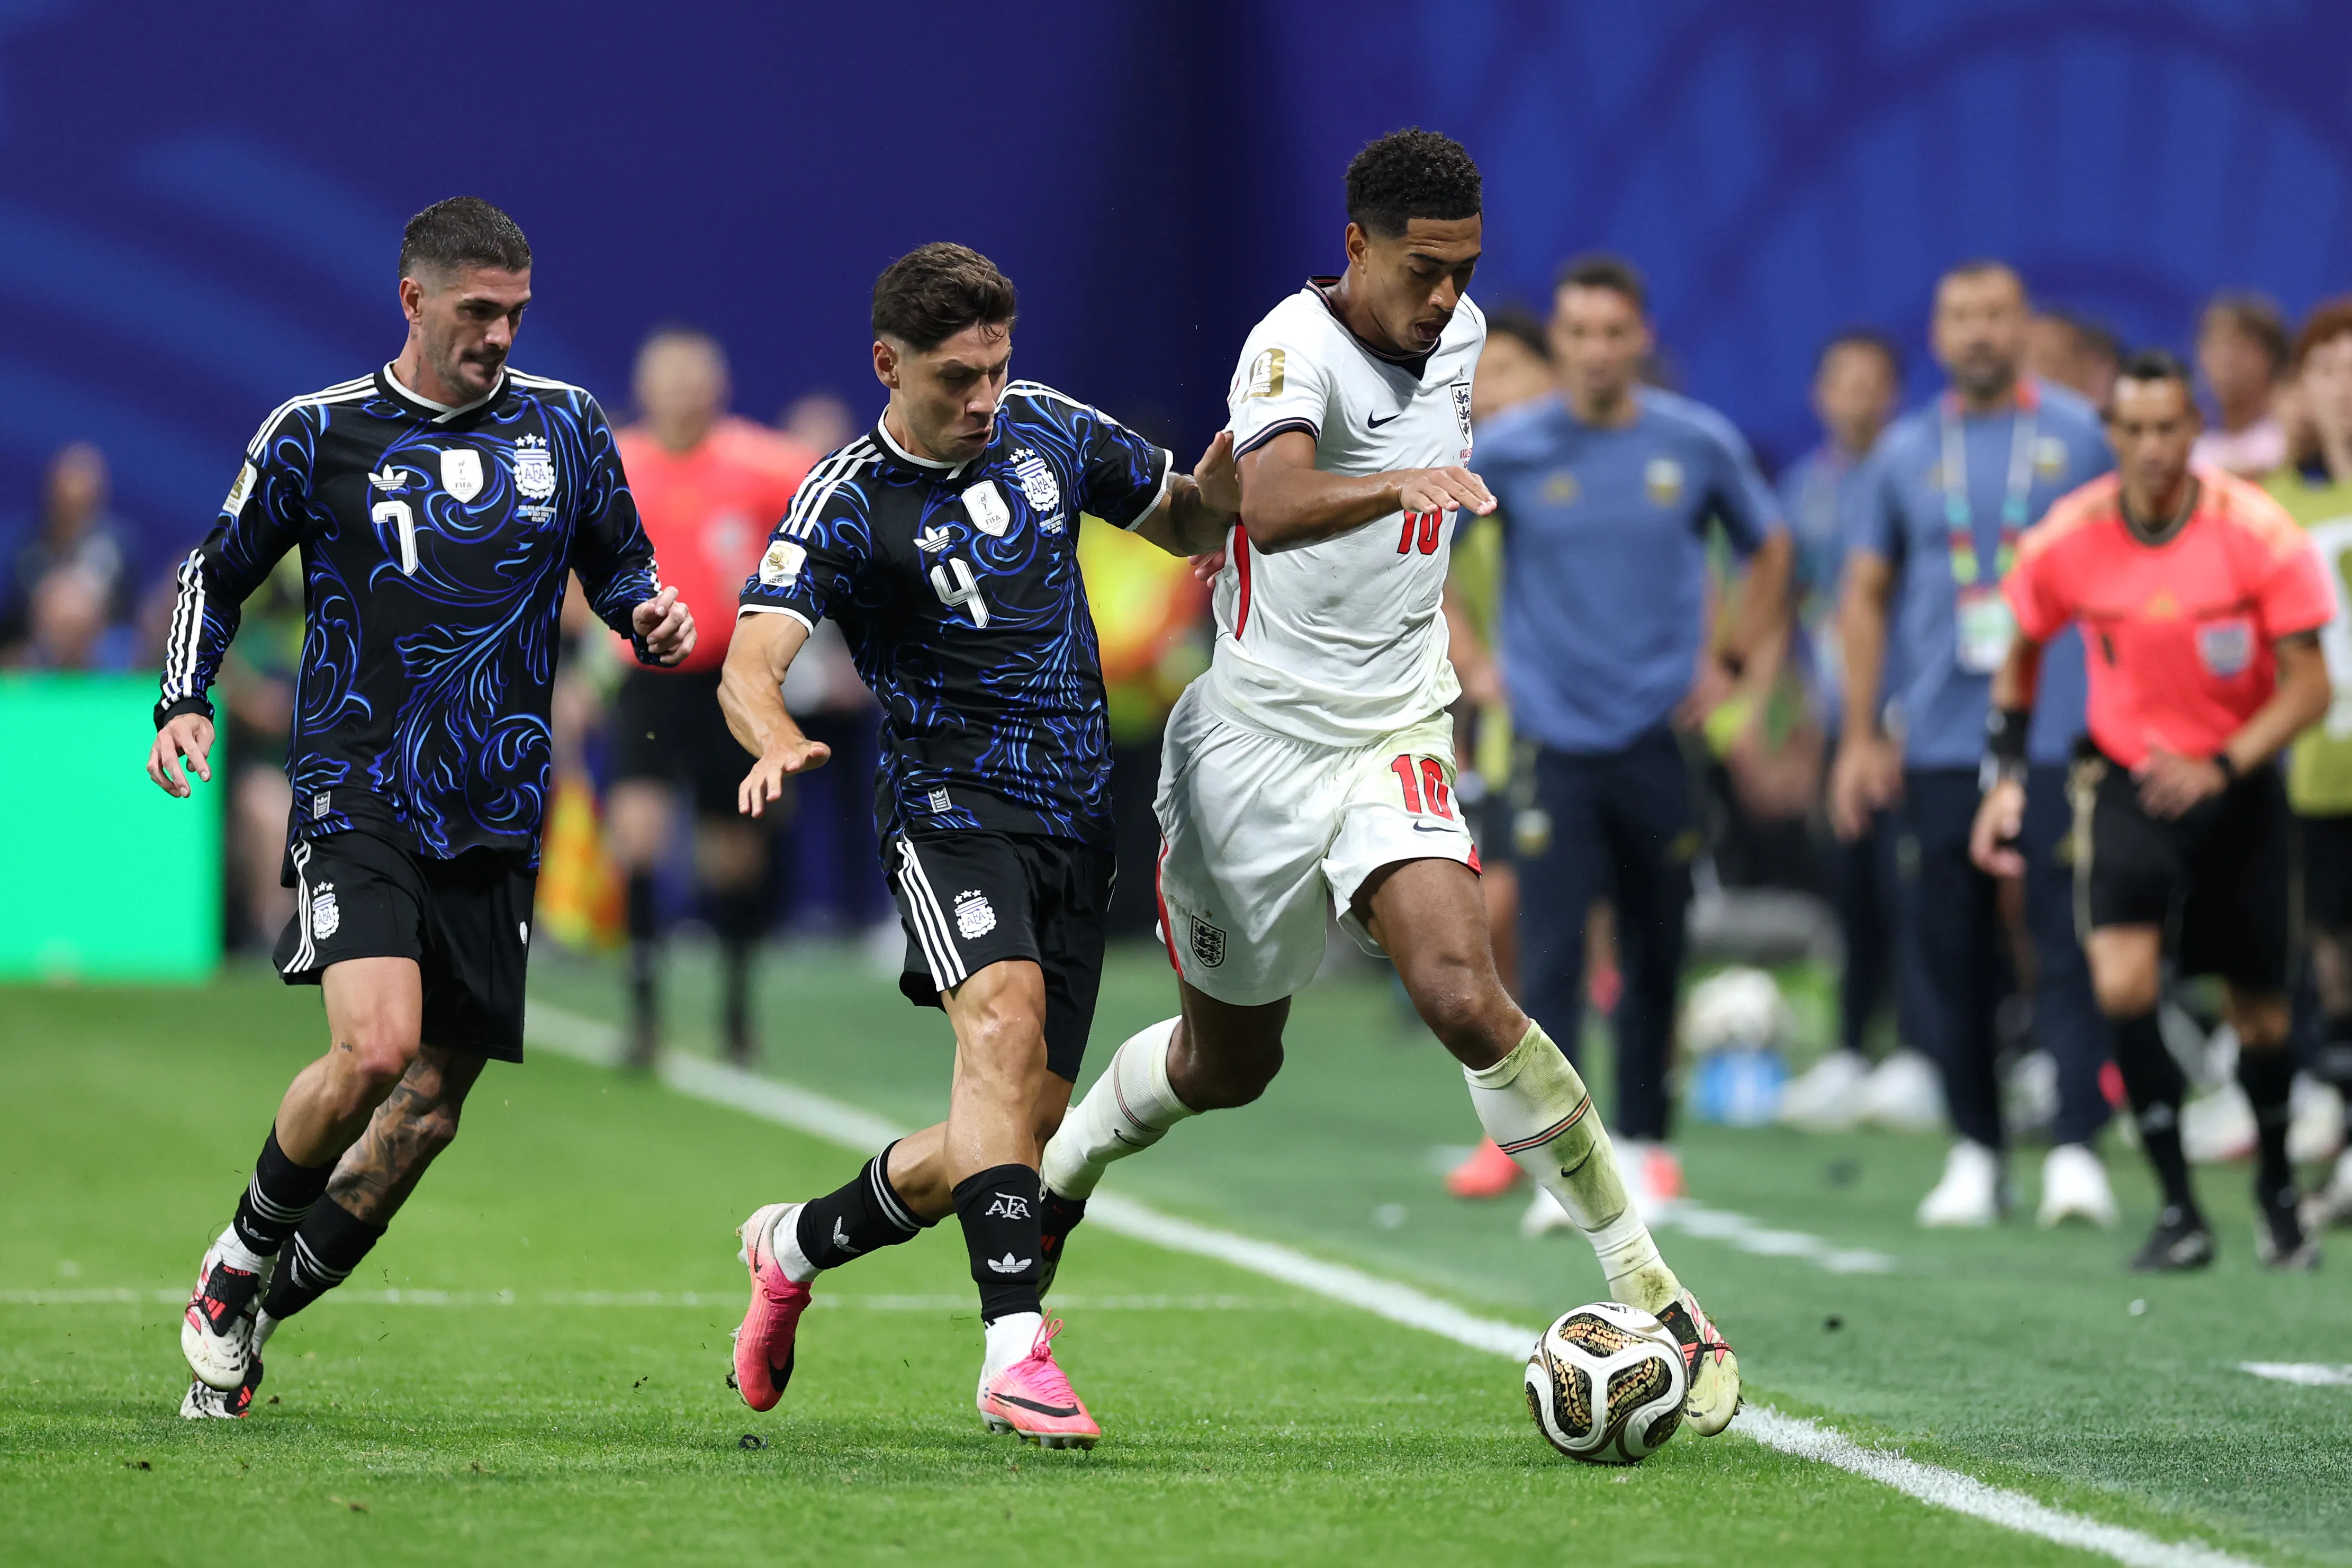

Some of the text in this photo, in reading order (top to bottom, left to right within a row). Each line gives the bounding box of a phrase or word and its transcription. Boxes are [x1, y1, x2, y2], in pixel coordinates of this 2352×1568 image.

[525, 462, 547, 483] AFA
[1028, 472, 1051, 495] AFA
[985, 515, 1001, 525] FIFA
[1396, 506, 1443, 555] 10
[372, 500, 419, 576] 7
[930, 557, 989, 628] 4
[1391, 754, 1455, 822] 10
[318, 906, 332, 925] AFA
[966, 908, 987, 926] AFA
[985, 1192, 1031, 1220] AFA
[1563, 1329, 1630, 1349] NEW JERSEY
[1564, 1322, 1631, 1342] NEW YORK
[1553, 1363, 1584, 1428] DALLAS
